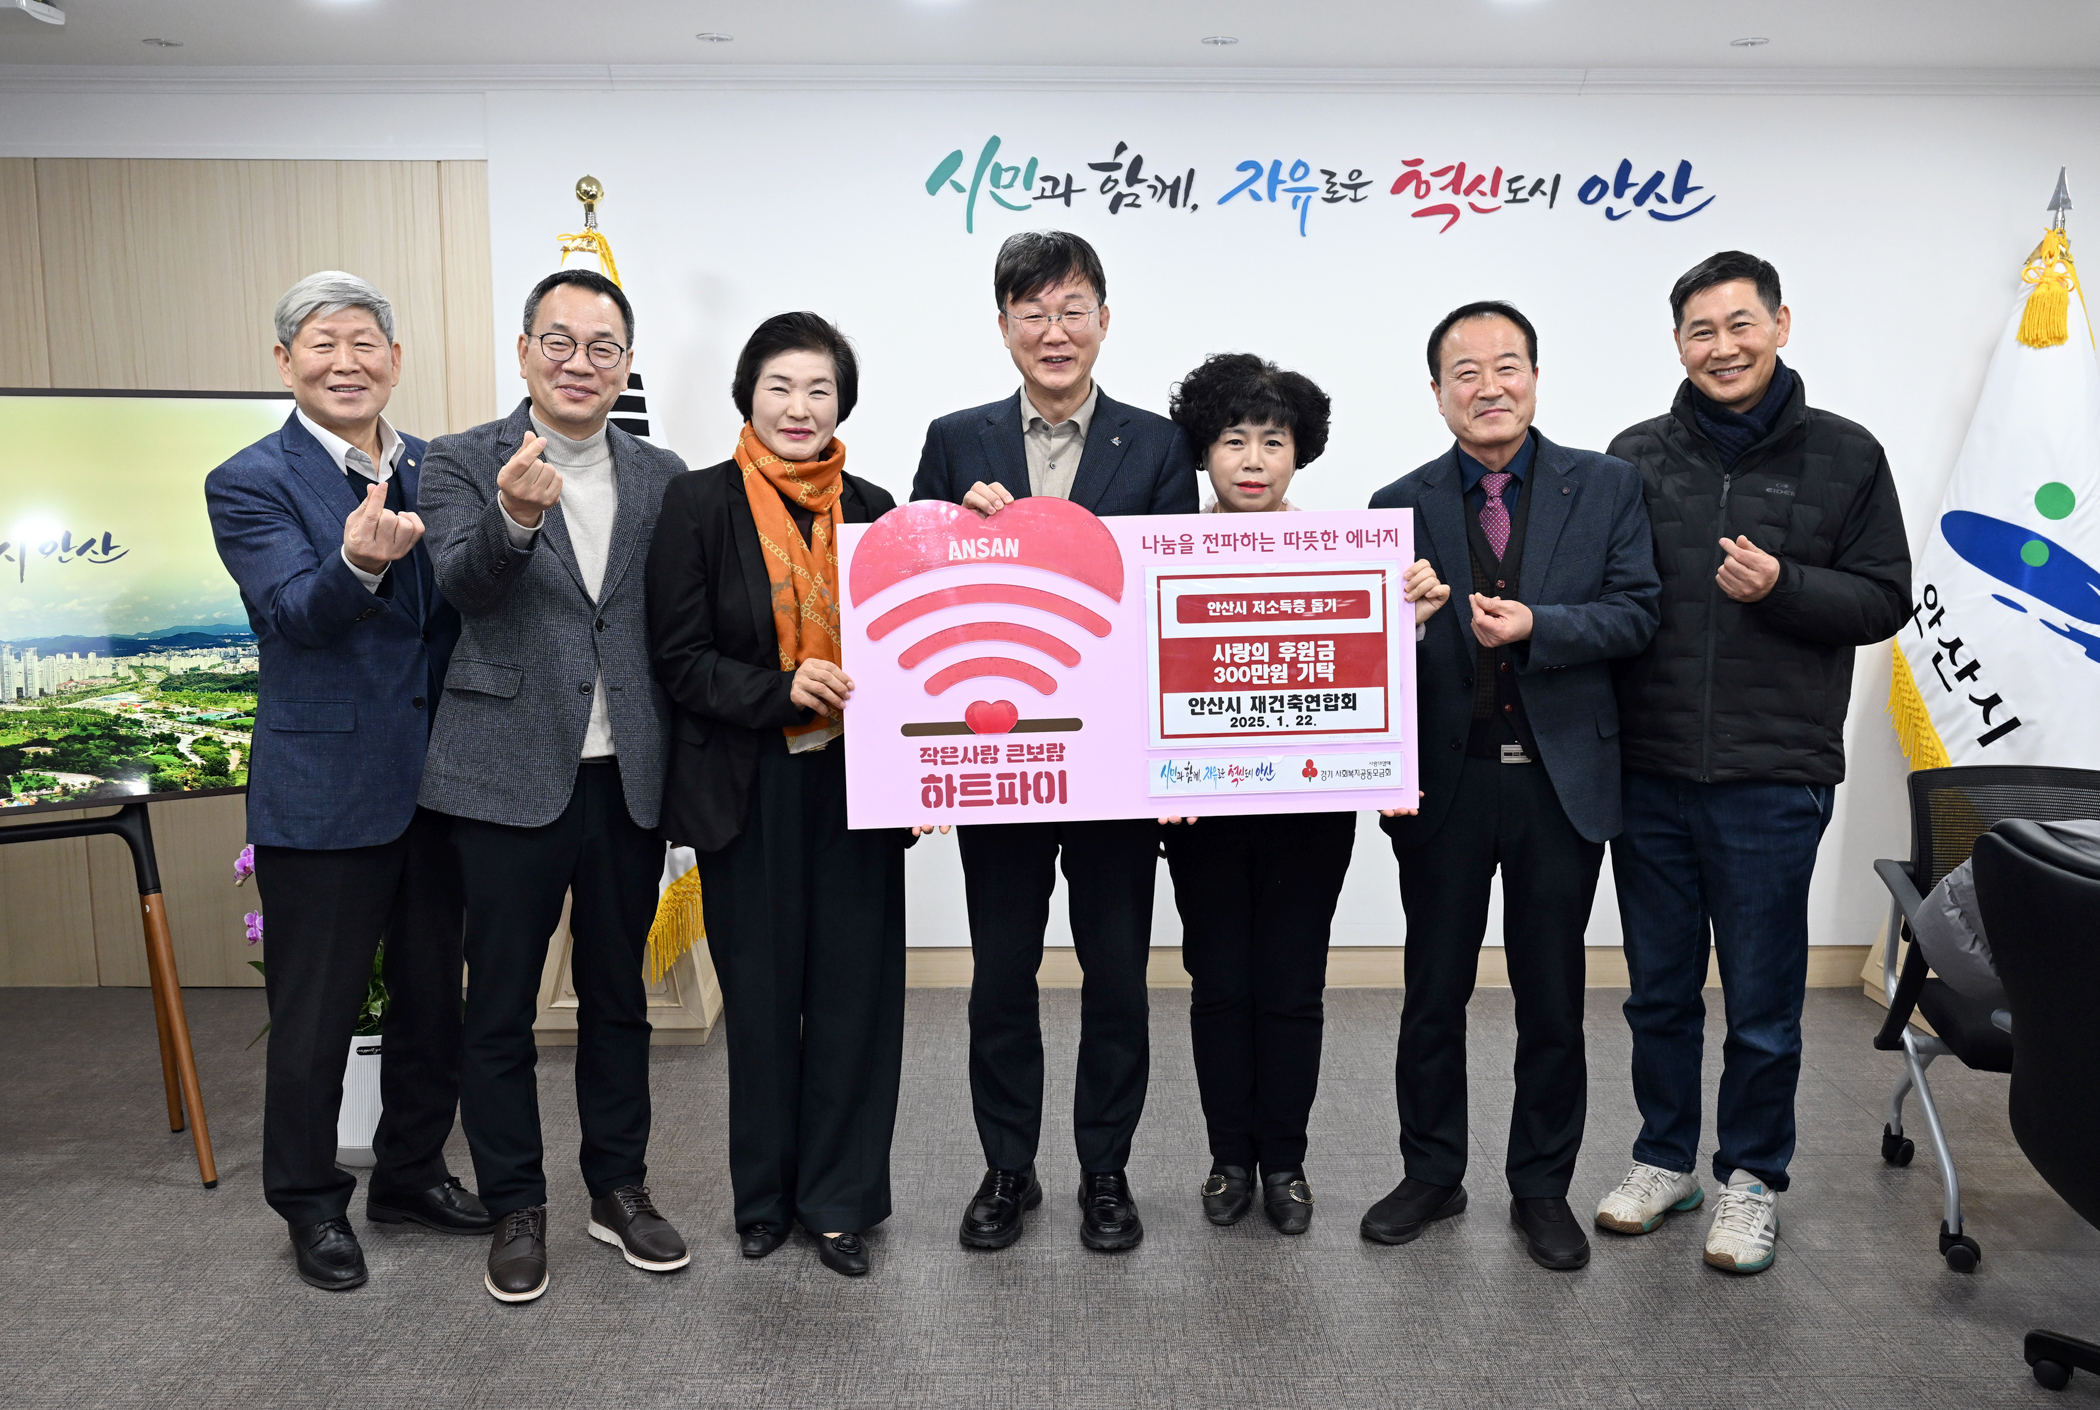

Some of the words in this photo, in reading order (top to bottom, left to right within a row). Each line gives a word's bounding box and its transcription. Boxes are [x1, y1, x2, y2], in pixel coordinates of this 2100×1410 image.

[925, 134, 1087, 234] 시민과
[1087, 140, 1199, 214] 함께,
[1217, 158, 1374, 237] 자유로운
[1390, 158, 1561, 234] 혁신도시
[1577, 158, 1716, 222] 안산
[1765, 487, 1796, 497] EIDER
[38, 530, 130, 564] 안산
[948, 537, 1019, 561] ANSAN
[1142, 533, 1195, 555] 나눔을
[1202, 532, 1276, 554] 전파하는
[1283, 529, 1339, 551] 따뜻한
[1345, 527, 1399, 548] 에너지
[1207, 600, 1247, 616] 안산시
[1252, 599, 1306, 615] 저소득층
[1310, 598, 1337, 613] 돕기
[1212, 642, 1270, 663] 사랑의
[1278, 640, 1336, 662] 후원금
[1213, 663, 1289, 684] 300만원
[1297, 662, 1336, 683] 기탁
[1913, 583, 2022, 748] 안산시
[1188, 696, 1242, 716] 안산시
[1249, 693, 1357, 714] 재건축연합회
[1230, 716, 1270, 729] 2025.
[1276, 715, 1290, 728] 1.
[1295, 714, 1317, 727] 22.
[919, 744, 1000, 766] 작은사랑
[1006, 742, 1066, 764] 큰보람
[1255, 761, 1276, 782] 안산
[1320, 769, 1334, 782] 경기
[1335, 767, 1392, 781] 사회복지공동모금회
[920, 769, 1068, 809] 하트파이
